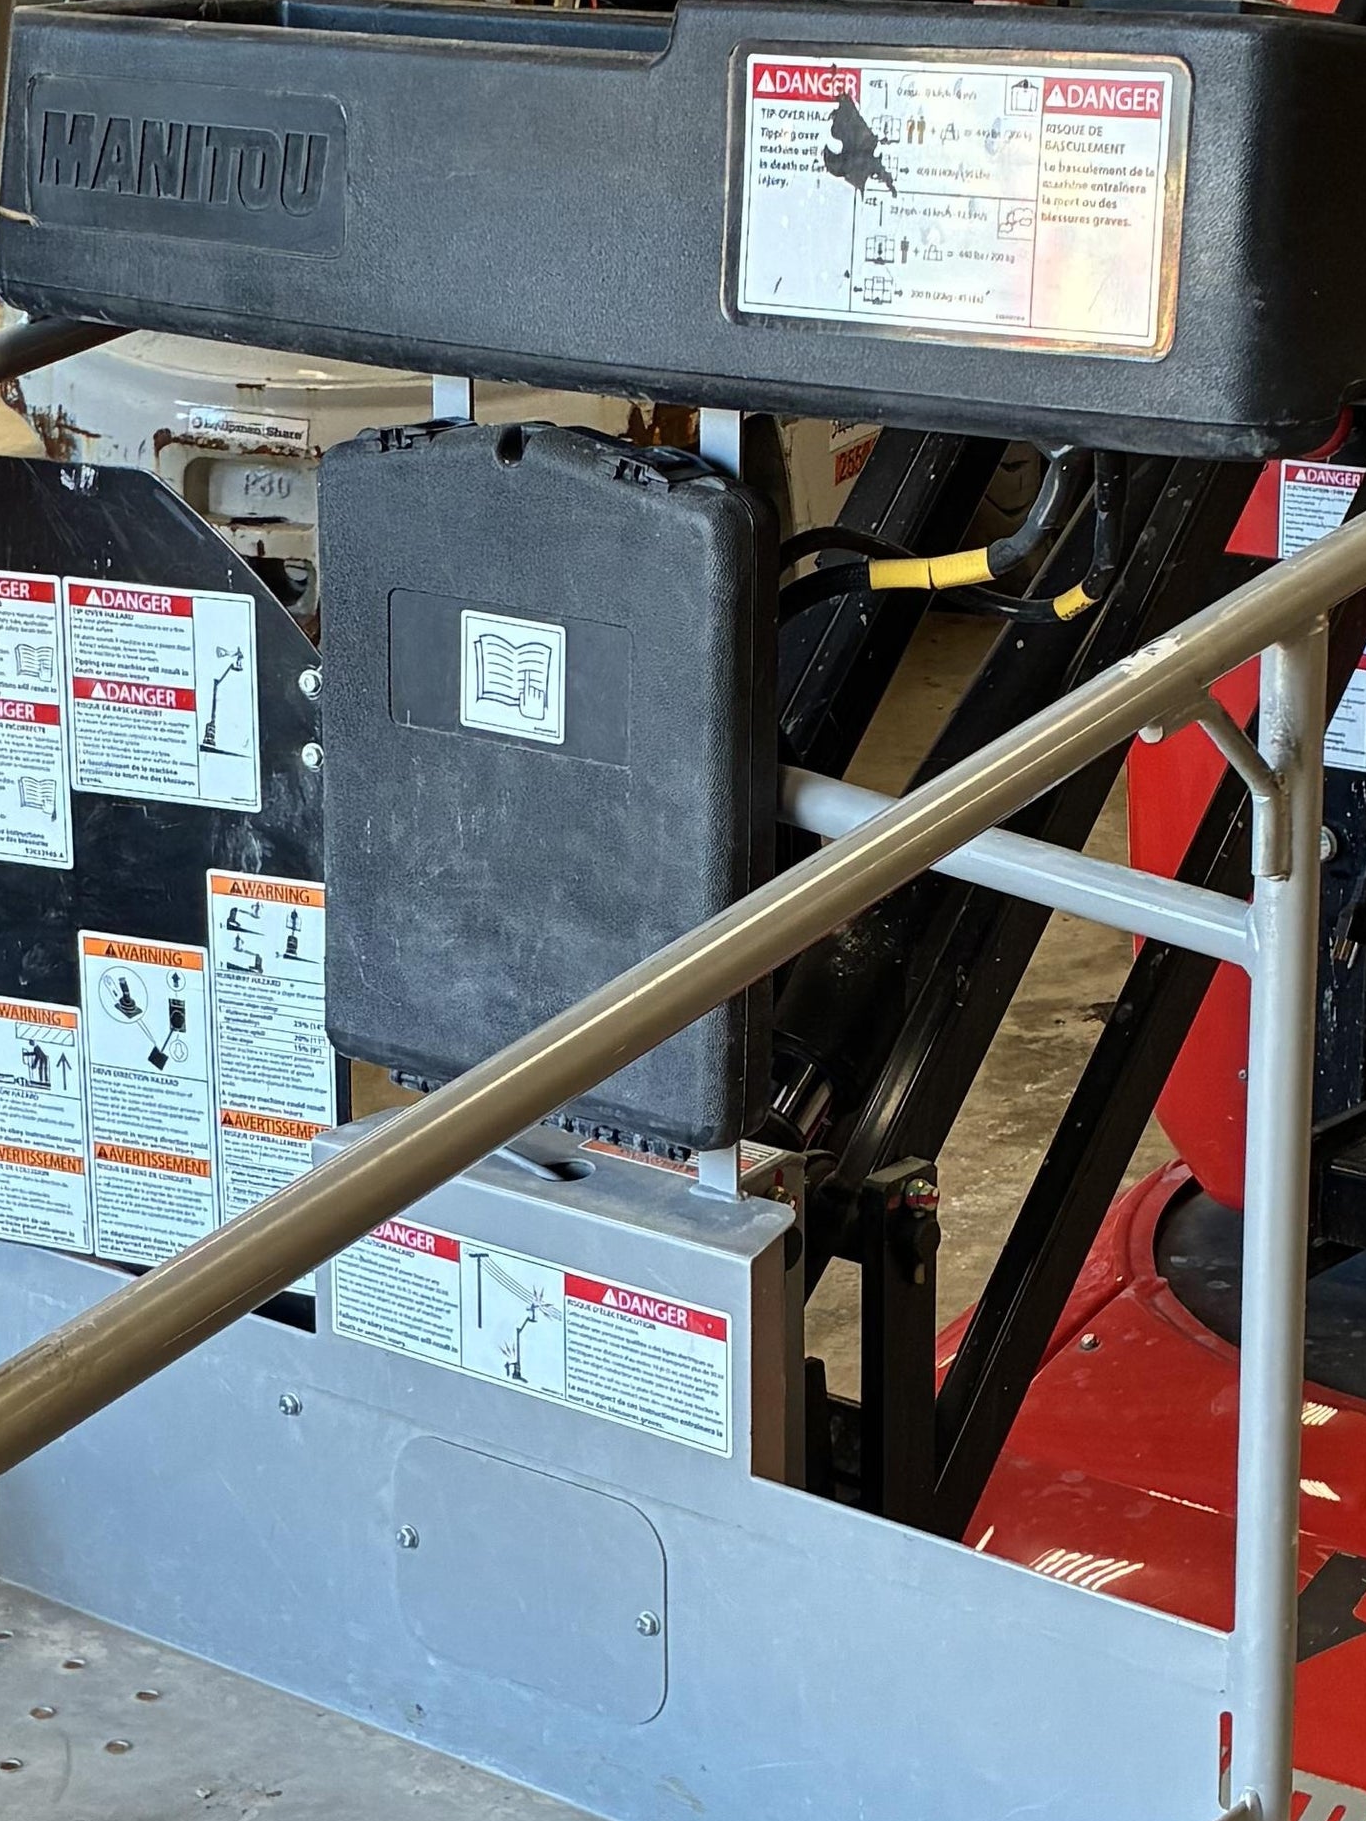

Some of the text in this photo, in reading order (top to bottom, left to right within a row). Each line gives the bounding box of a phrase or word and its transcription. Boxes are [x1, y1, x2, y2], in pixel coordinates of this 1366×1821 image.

[775, 70, 857, 98] DANGER
[1067, 84, 1160, 113] DANGER
[1045, 140, 1126, 155] BASCULEMENT
[39, 110, 330, 217] MANITOU
[1307, 469, 1360, 486] DANGER
[101, 590, 172, 613] DANGER
[106, 682, 177, 708] DANGER
[242, 882, 310, 904] WARNING
[118, 943, 183, 967] WARNING
[109, 1147, 209, 1176] AVERTISSEMENT
[619, 1292, 688, 1328] DANGER
